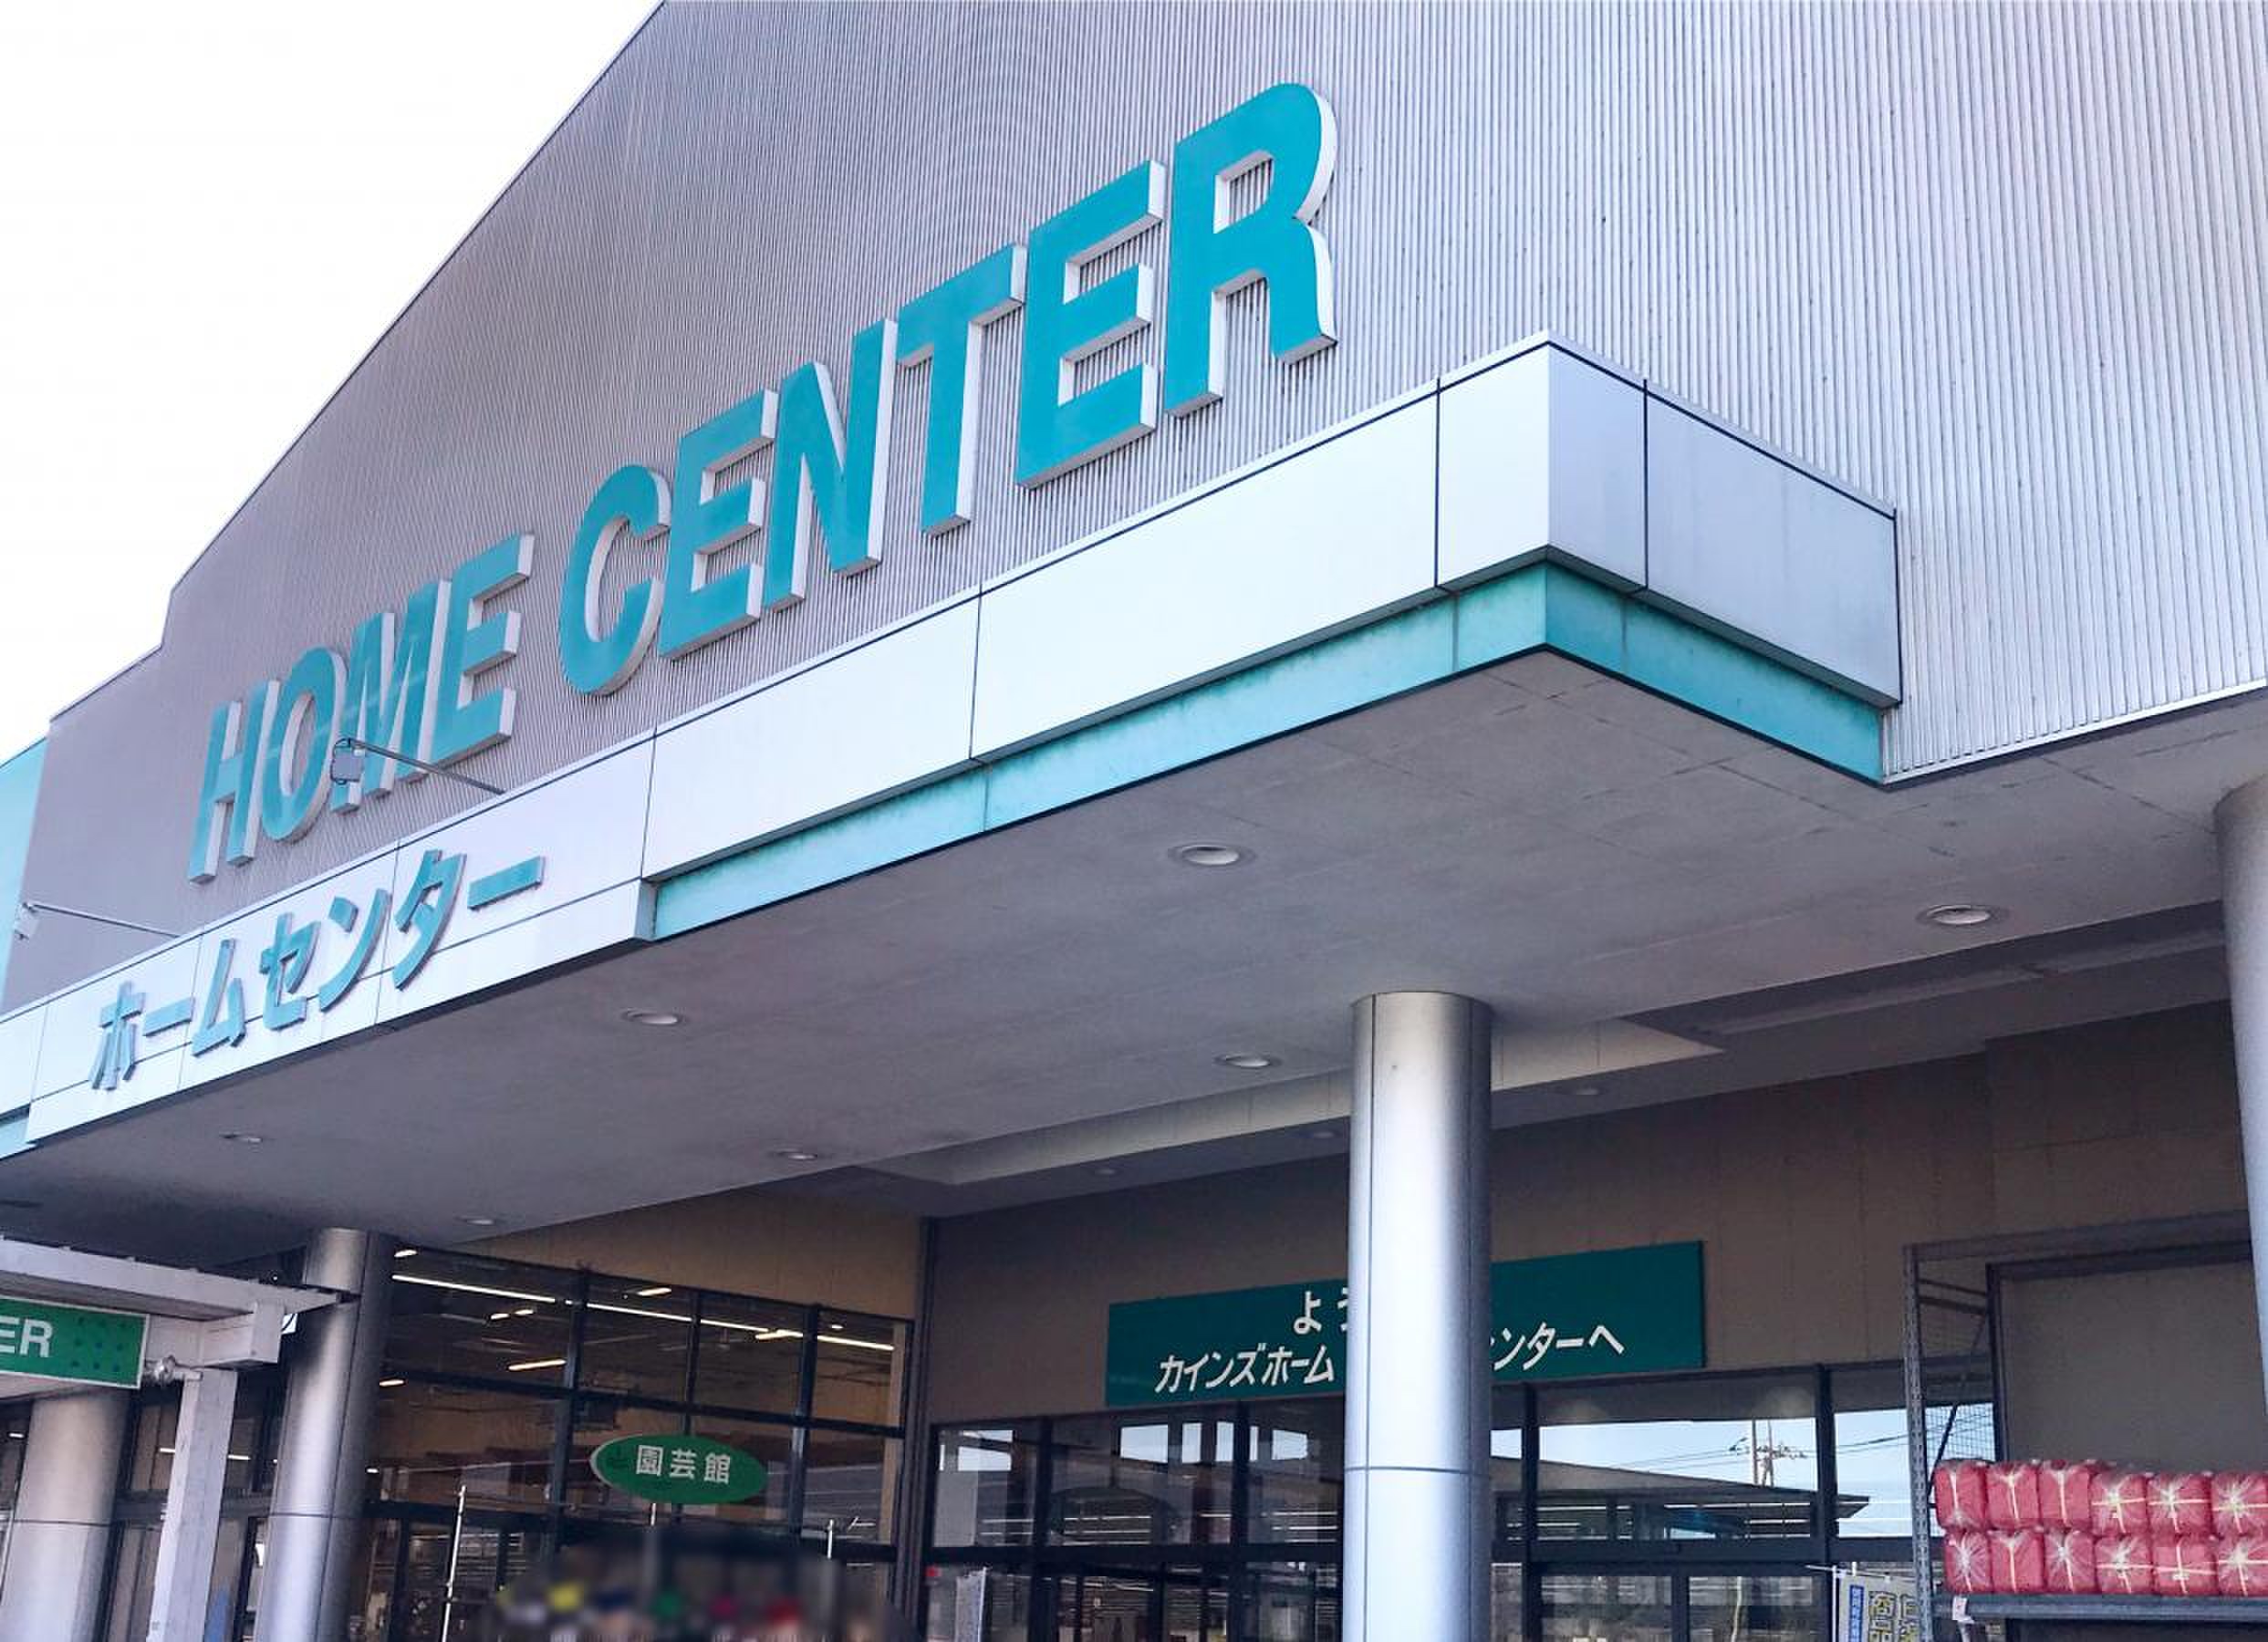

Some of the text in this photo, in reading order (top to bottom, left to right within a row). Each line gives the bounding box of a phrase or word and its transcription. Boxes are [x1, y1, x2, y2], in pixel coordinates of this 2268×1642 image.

[189, 82, 1337, 885] HOME CENTER
[90, 848, 546, 1090] ホームセンター
[1154, 1322, 1624, 1393] カインズホーム ンターへ
[636, 1445, 731, 1484] 園芸館
